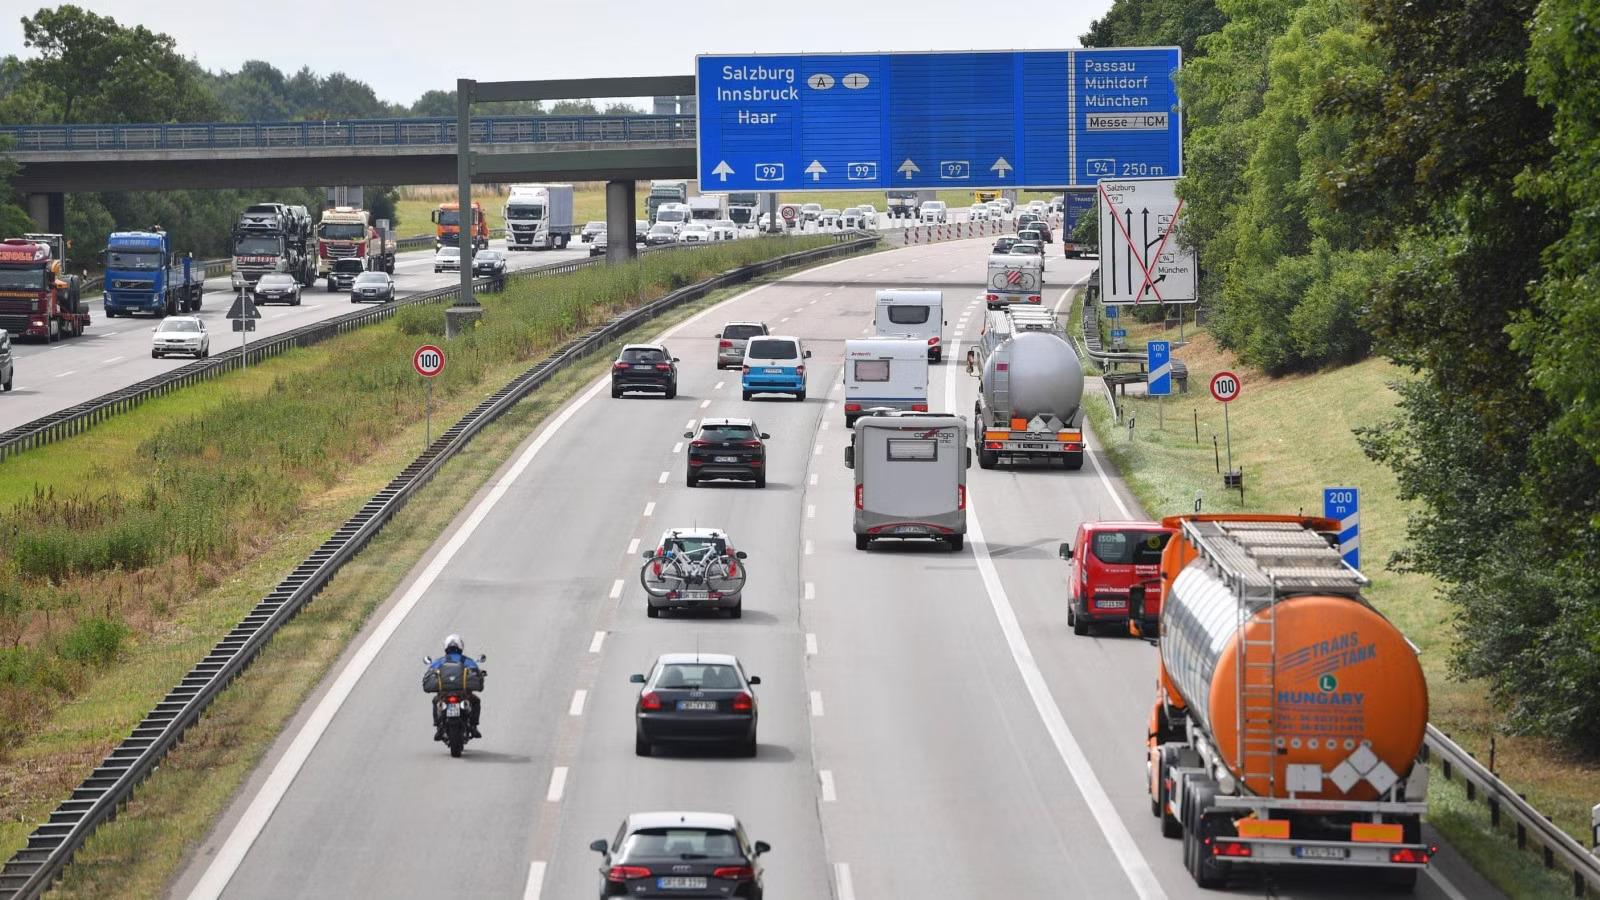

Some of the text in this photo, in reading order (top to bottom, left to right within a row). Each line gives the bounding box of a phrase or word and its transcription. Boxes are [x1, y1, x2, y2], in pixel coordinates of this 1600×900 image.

[1085, 60, 1135, 72] Passau
[722, 66, 795, 83] Salzburg
[817, 77, 825, 87] A
[1085, 76, 1148, 89] Mühldorf
[717, 86, 799, 101] Innsbruck
[1085, 94, 1148, 106] München
[738, 110, 777, 124] Haar
[1090, 117, 1128, 127] Messe
[1143, 116, 1165, 127] ICM
[763, 167, 777, 177] 99
[855, 166, 869, 177] 99
[948, 165, 962, 175] 99
[1094, 162, 1108, 173] 94
[1122, 163, 1163, 175] 250 m
[1158, 266, 1188, 274] München
[1152, 344, 1165, 352] 100
[420, 354, 438, 368] 100
[1216, 379, 1235, 394] 100
[1329, 491, 1353, 503] 200
[1311, 631, 1359, 658] TRANS
[1341, 643, 1377, 666] TANK
[1278, 691, 1364, 705] HUNGARY
